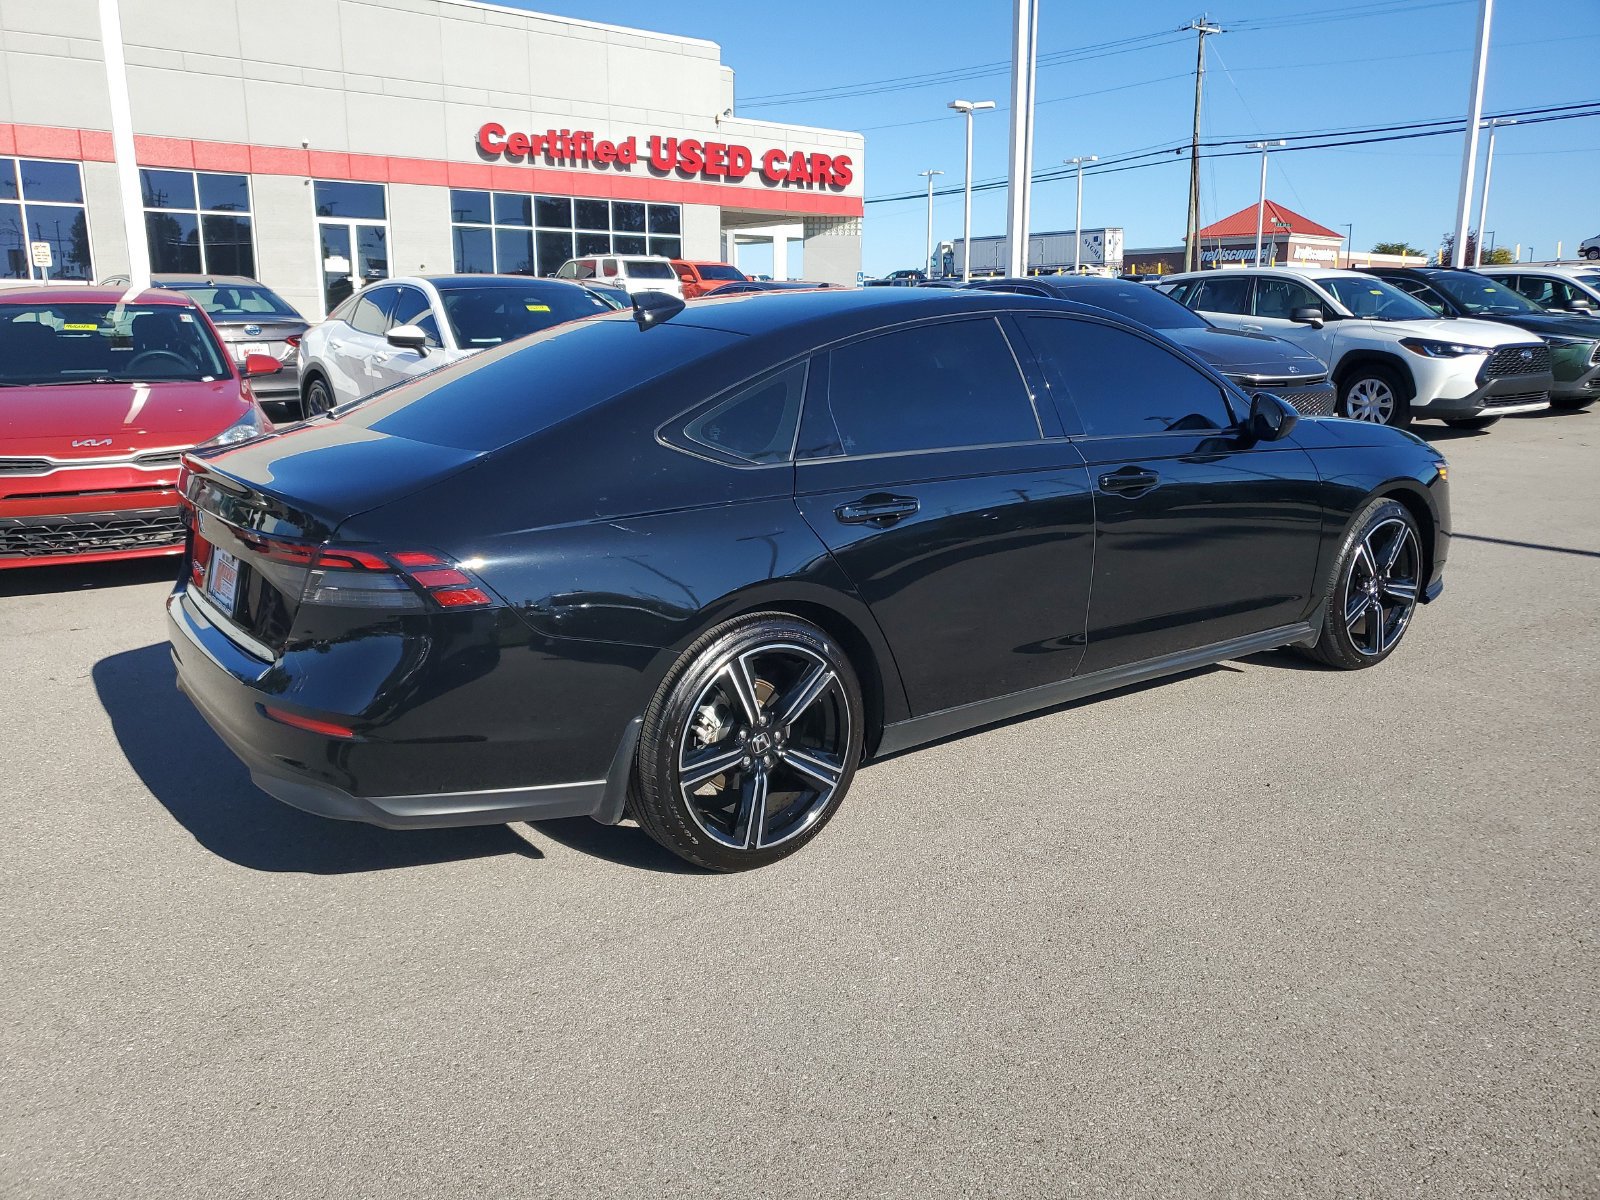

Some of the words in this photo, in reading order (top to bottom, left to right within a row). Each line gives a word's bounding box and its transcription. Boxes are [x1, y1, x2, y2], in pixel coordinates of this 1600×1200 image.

[478, 122, 637, 165] Certified
[650, 135, 752, 178] USED
[763, 148, 853, 187] CARS
[1083, 238, 1102, 260] SYGMA
